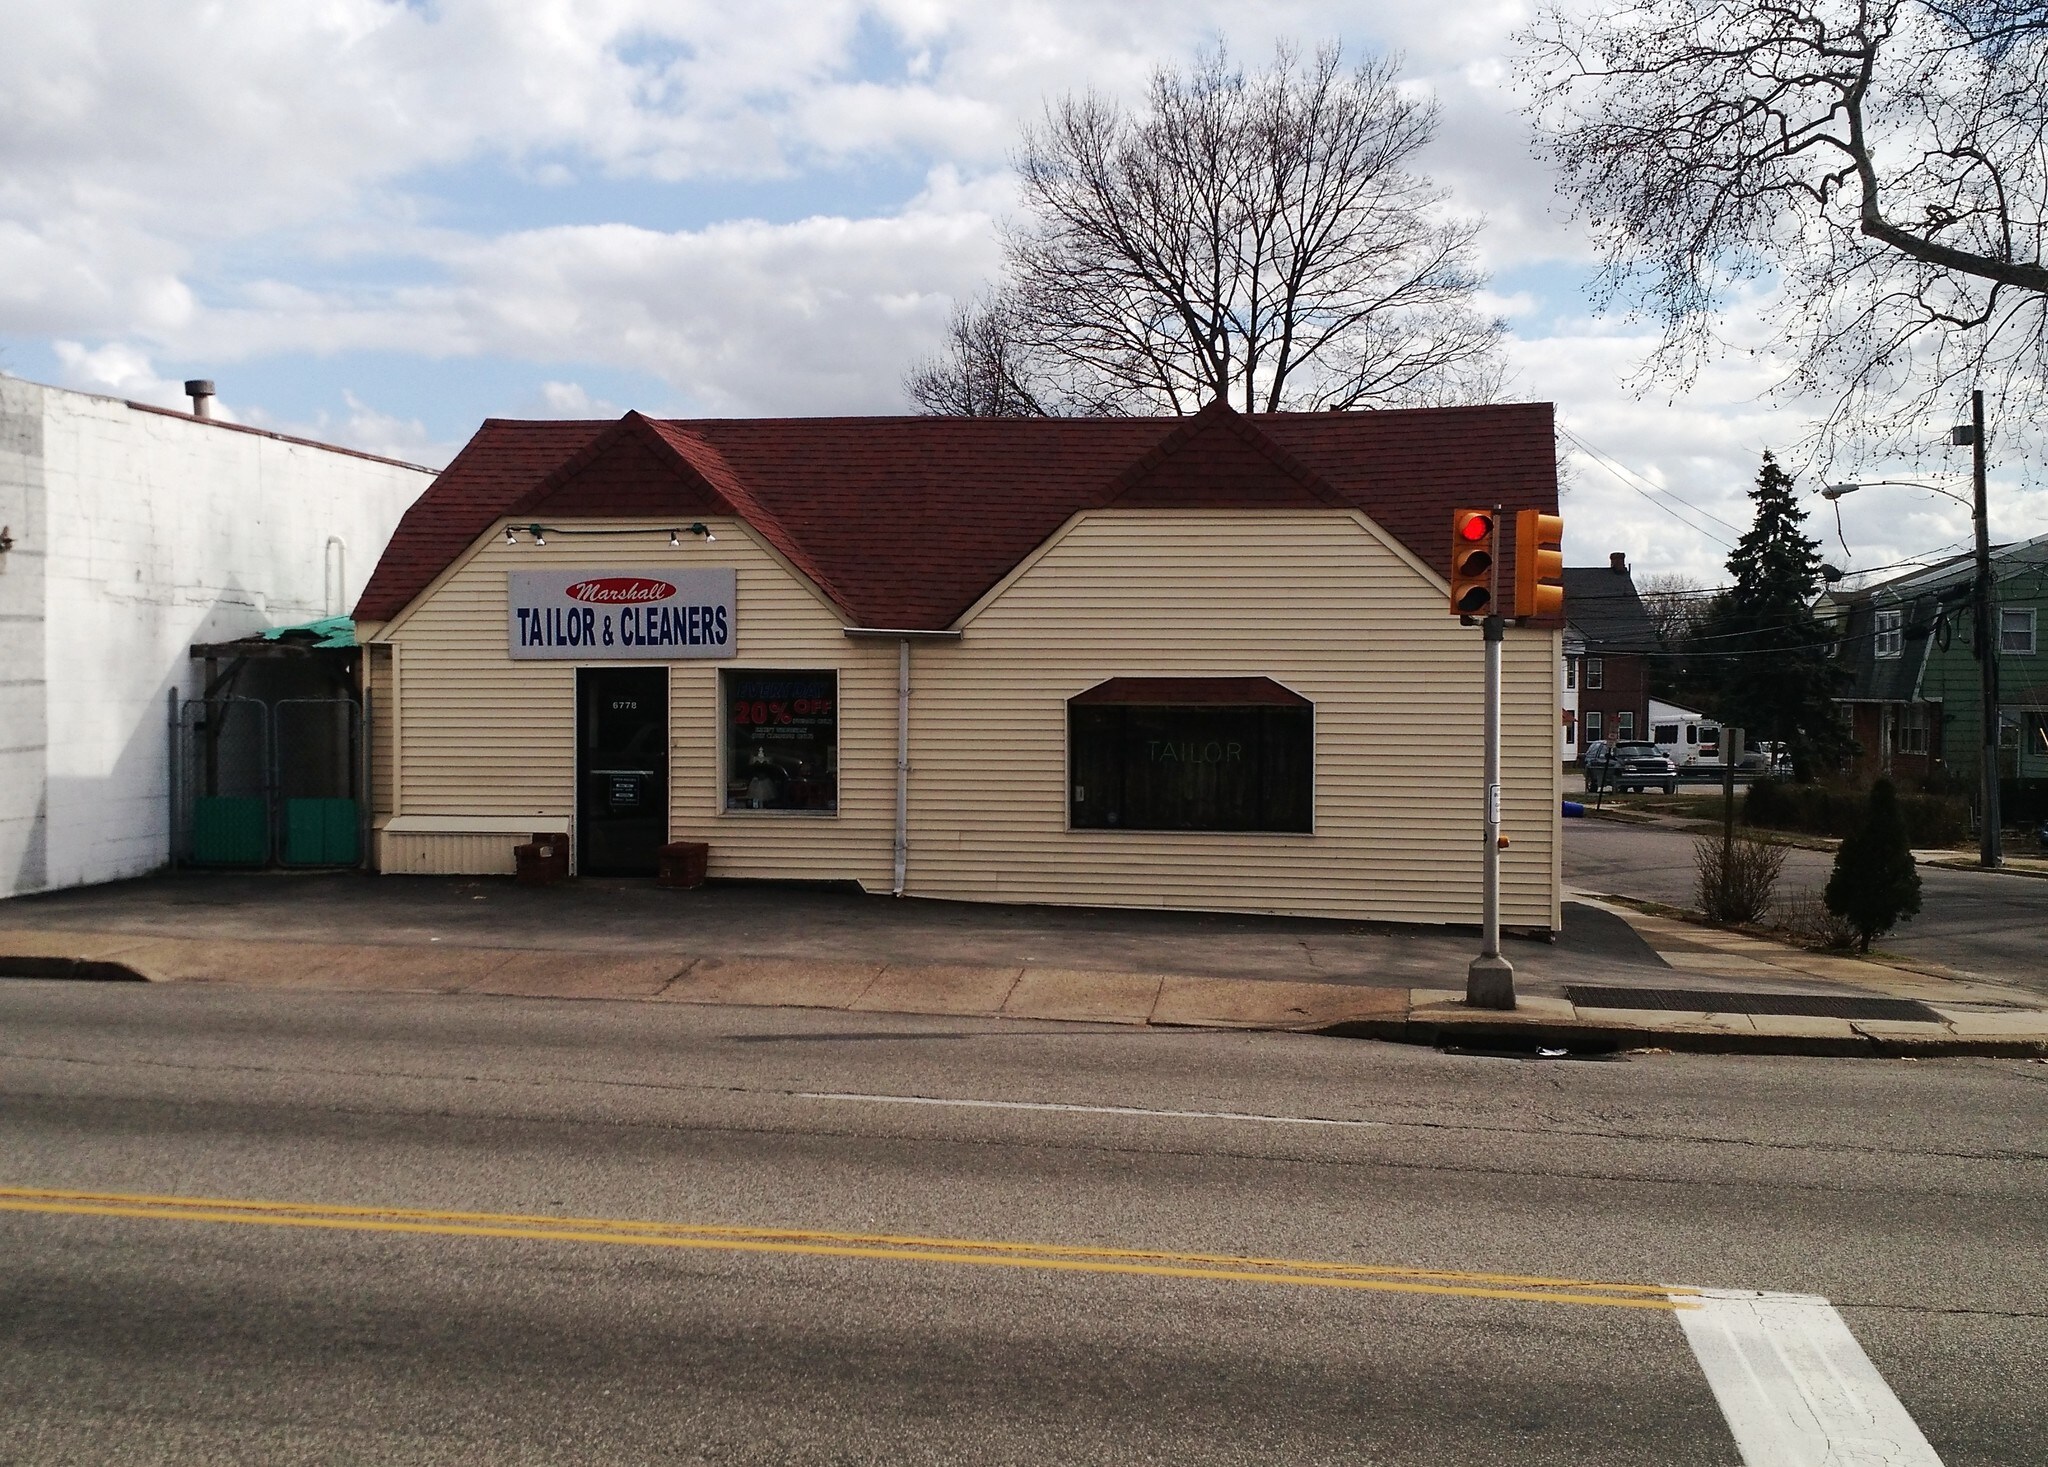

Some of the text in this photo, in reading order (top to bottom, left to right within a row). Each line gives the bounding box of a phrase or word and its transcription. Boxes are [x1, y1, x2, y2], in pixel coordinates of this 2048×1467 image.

[575, 582, 665, 602] Marshall
[517, 605, 728, 647] TAILOR & CLEANERS
[612, 701, 637, 710] 6778
[734, 699, 832, 725] 20% OFF
[1148, 741, 1242, 763] TAILOR
